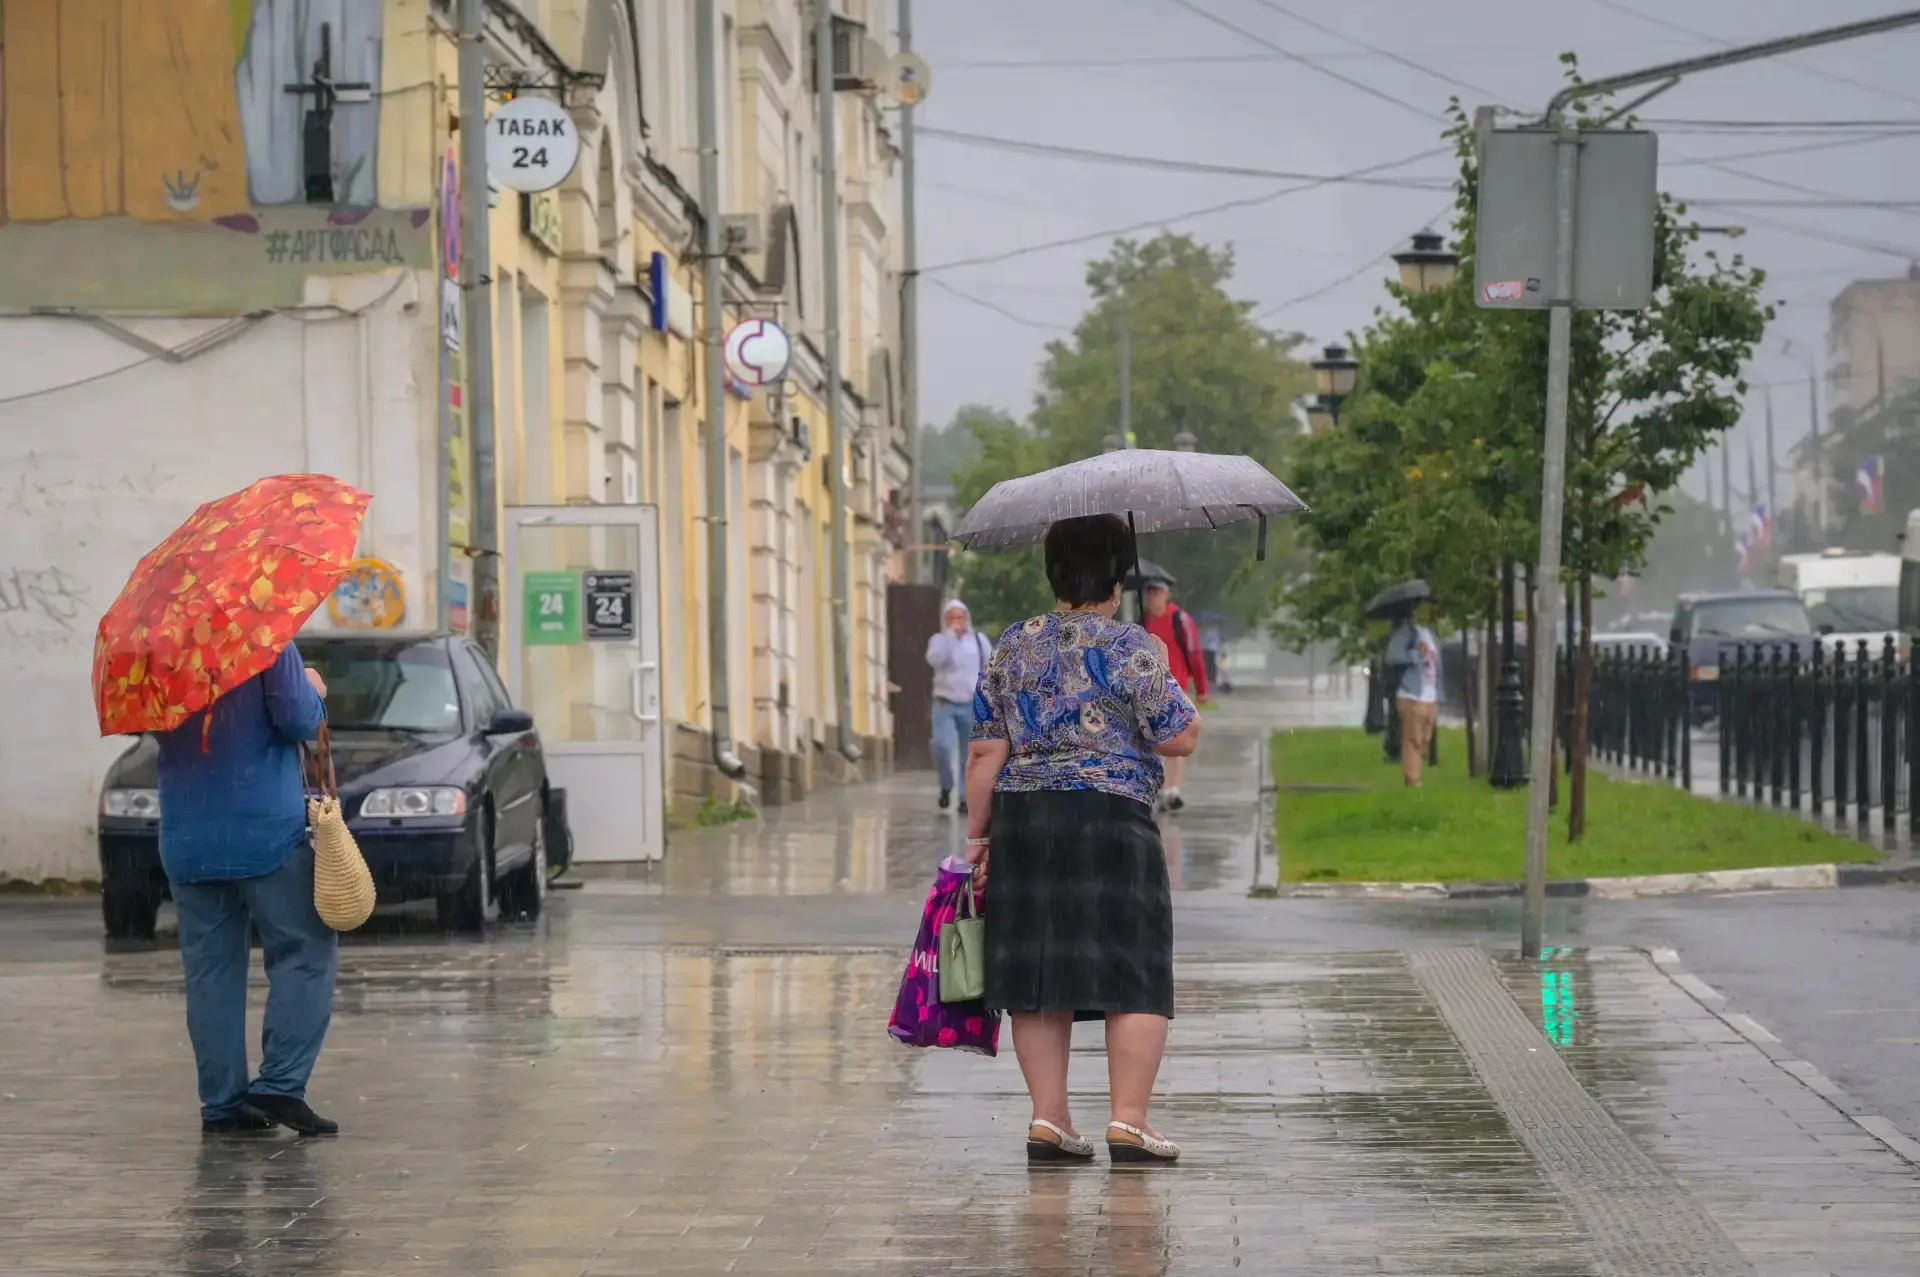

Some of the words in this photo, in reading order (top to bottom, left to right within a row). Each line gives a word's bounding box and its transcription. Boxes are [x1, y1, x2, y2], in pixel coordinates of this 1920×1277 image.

[496, 118, 566, 137] ТАБАК
[512, 147, 549, 169] 24
[264, 227, 405, 264] #АРТФАСАД
[539, 592, 564, 616] 24
[595, 597, 624, 618] 24
